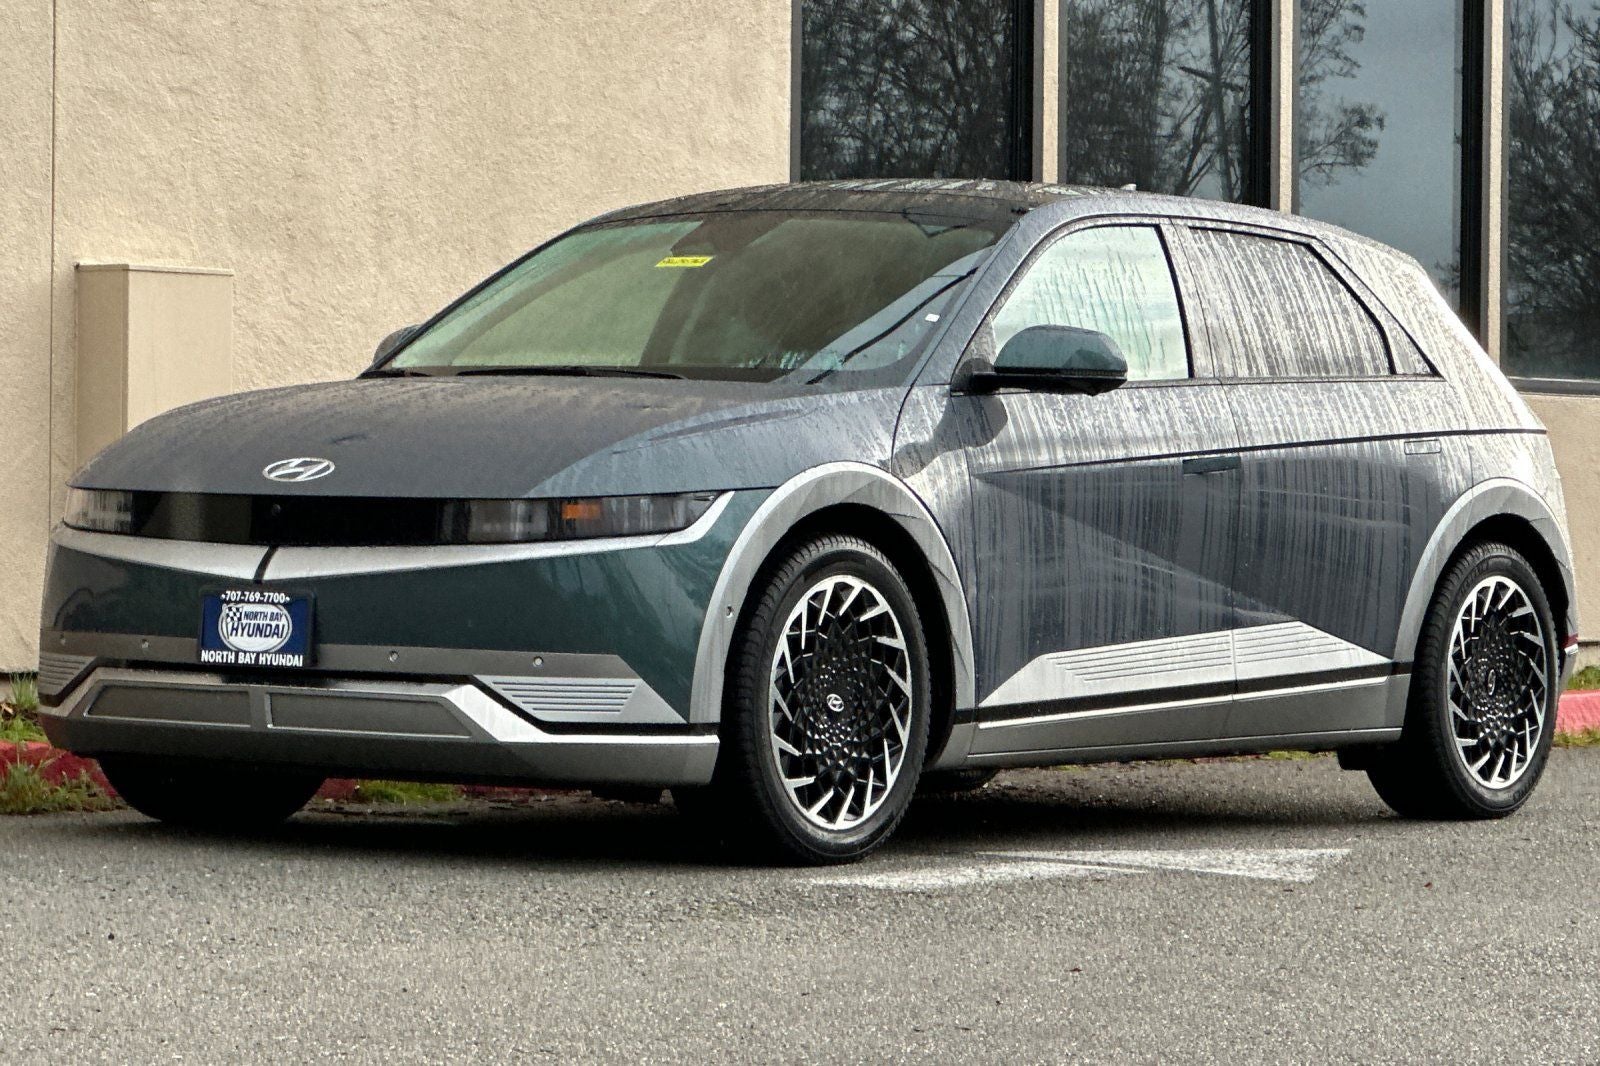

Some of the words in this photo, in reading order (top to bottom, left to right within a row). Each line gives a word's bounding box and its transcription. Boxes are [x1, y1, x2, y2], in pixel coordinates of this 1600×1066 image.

[244, 611, 267, 622] NORTH
[269, 612, 284, 622] BAY
[230, 622, 286, 638] HYUNDAI
[201, 650, 235, 663] NORTH
[238, 652, 256, 665] BAY
[259, 653, 304, 667] HYUNDAI
